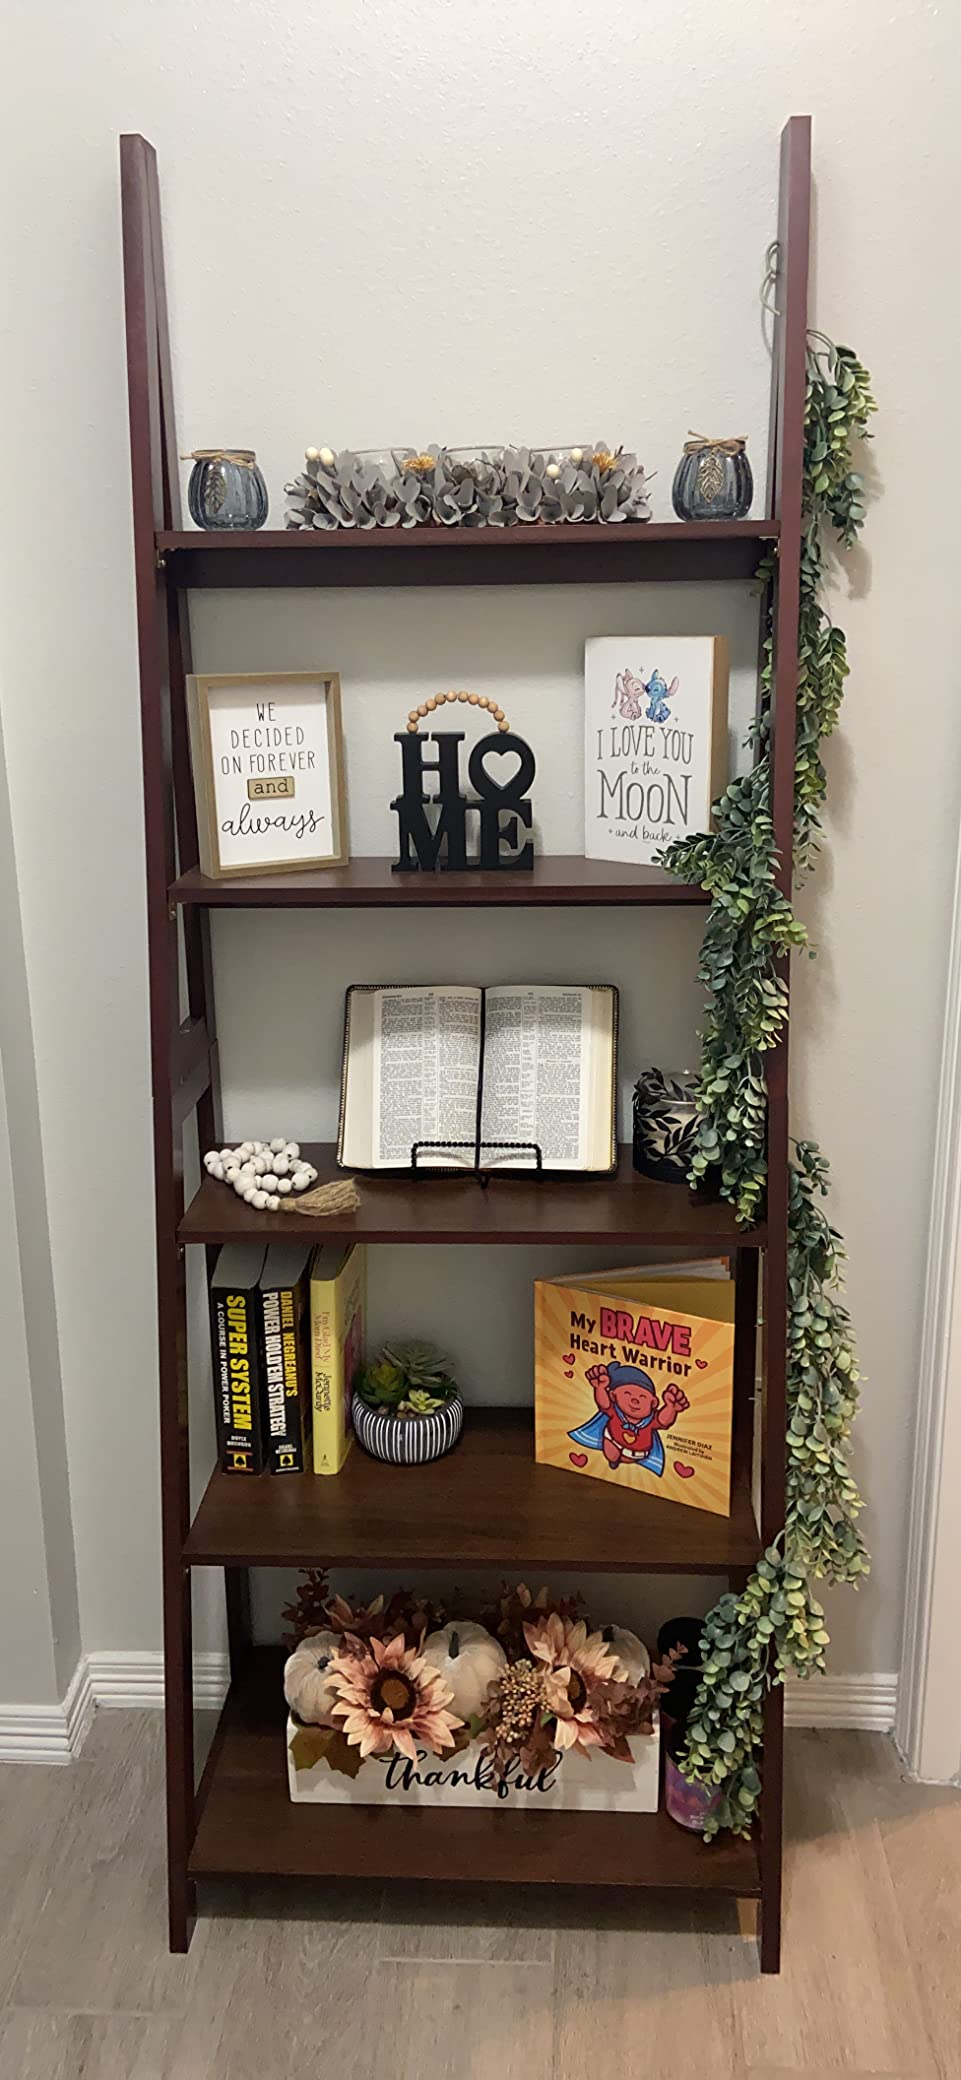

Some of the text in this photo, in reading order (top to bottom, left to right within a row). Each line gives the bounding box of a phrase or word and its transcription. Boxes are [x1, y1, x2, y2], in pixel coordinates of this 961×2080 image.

[256, 702, 276, 722] WE
[230, 726, 305, 749] DECIDED
[597, 725, 694, 764] I LOVE YOU
[221, 750, 316, 775] ON FOREVER
[630, 761, 661, 775] to the
[254, 778, 289, 795] and
[596, 769, 693, 826] MOON
[221, 802, 325, 839] always
[615, 825, 673, 842] and back
[262, 1292, 281, 1335] POWER
[280, 1291, 294, 1329] DANIEL
[217, 1311, 227, 1348] COURSE
[570, 1306, 692, 1357] My BRAVE
[219, 1349, 228, 1359] IN
[226, 1295, 253, 1430] SUPER SYSTEM
[570, 1333, 692, 1377] Heart Warrior
[220, 1361, 230, 1392] POWER
[222, 1394, 231, 1424] POKER
[267, 1383, 287, 1437] STRATEGY
[697, 1441, 713, 1450] DIAZ
[379, 1750, 563, 1799] thankful
